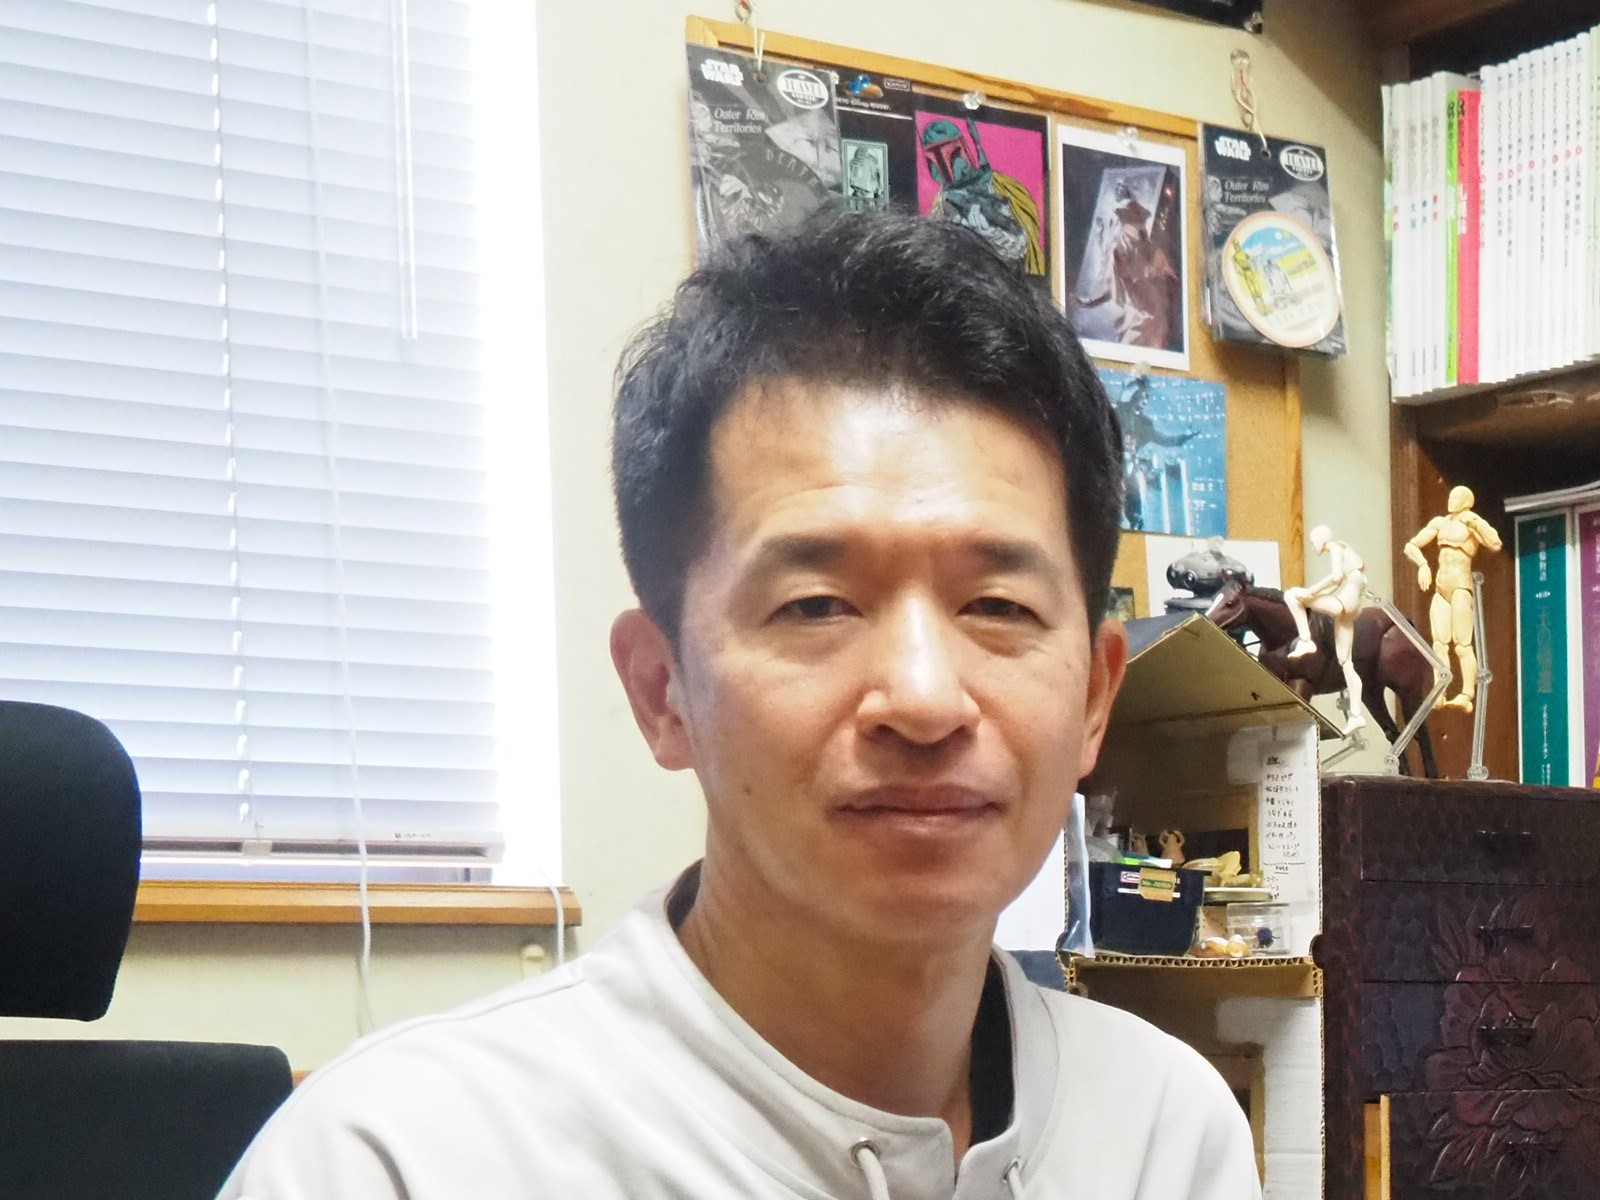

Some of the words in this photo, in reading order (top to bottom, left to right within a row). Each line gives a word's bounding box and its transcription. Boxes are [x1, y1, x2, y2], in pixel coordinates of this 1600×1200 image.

[702, 58, 741, 75] STAR
[713, 107, 742, 120] Outer
[745, 108, 766, 121] Rim
[712, 120, 763, 134] Territories
[1214, 135, 1248, 150] STAR
[1223, 179, 1248, 192] Outer
[1251, 179, 1270, 192] Rim
[1223, 191, 1267, 203] Territories
